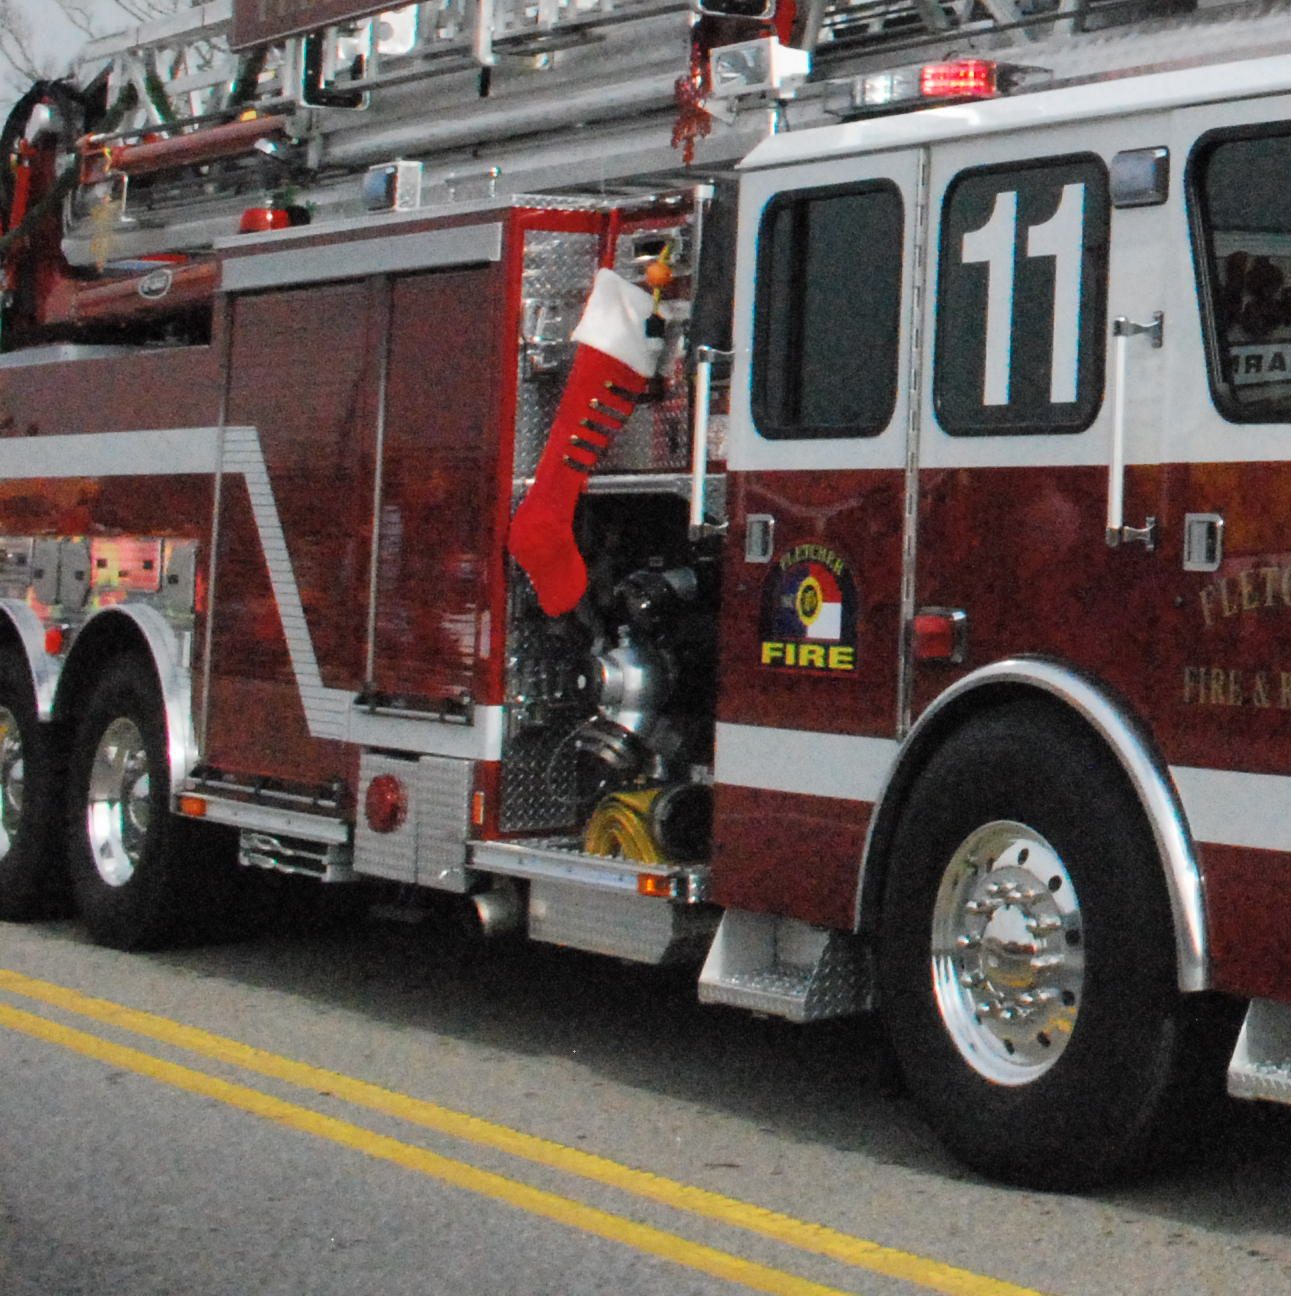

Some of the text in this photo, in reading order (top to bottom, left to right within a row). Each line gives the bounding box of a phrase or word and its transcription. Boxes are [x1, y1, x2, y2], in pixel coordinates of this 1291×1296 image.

[961, 182, 1086, 407] 11
[761, 641, 855, 670] FIRE
[1184, 667, 1243, 706] FIRE
